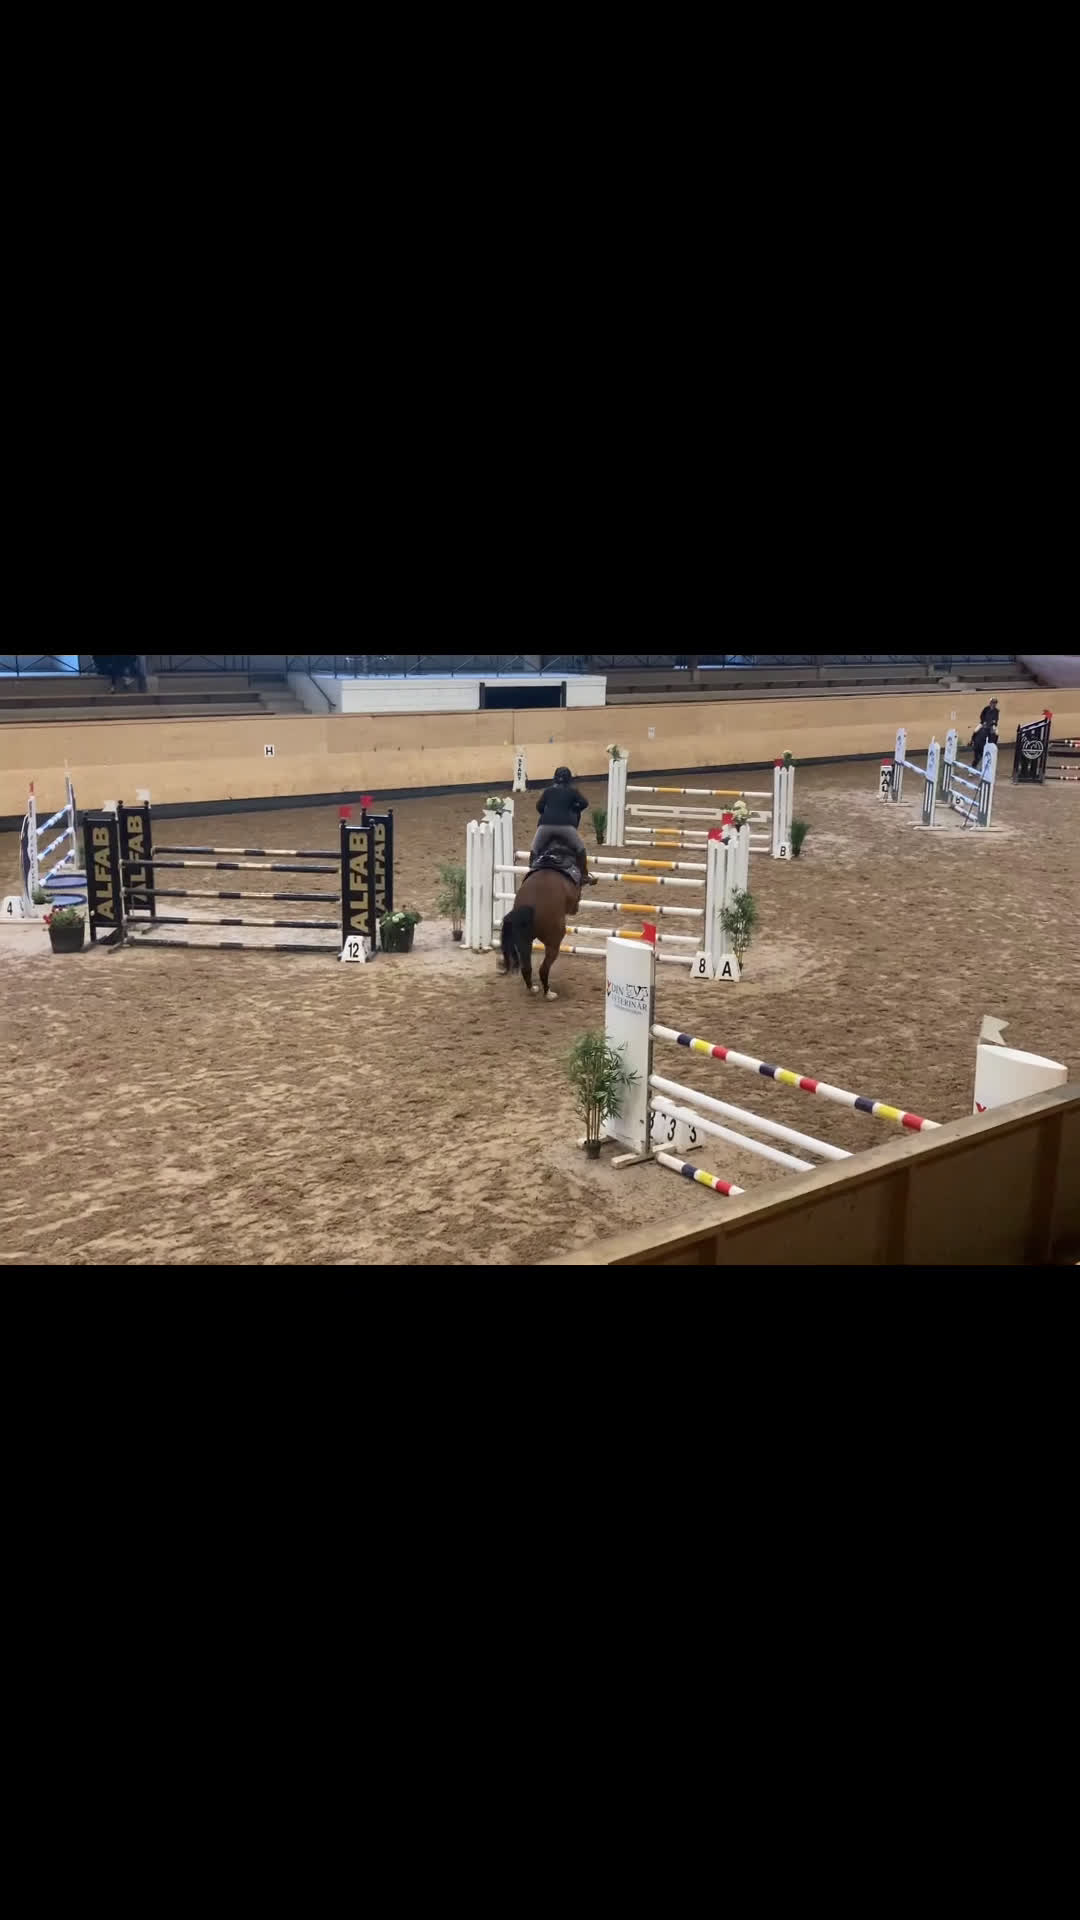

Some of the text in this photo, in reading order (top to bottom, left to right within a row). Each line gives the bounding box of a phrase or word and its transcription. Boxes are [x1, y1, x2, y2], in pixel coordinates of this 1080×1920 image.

[265, 746, 273, 755] H
[780, 845, 786, 857] B
[93, 826, 115, 920] ALFAB
[349, 832, 369, 933] ALFAB
[7, 901, 13, 916] 4
[348, 942, 359, 958] 12
[699, 958, 706, 974] 8
[722, 961, 732, 977] A
[667, 1118, 677, 1142] 3
